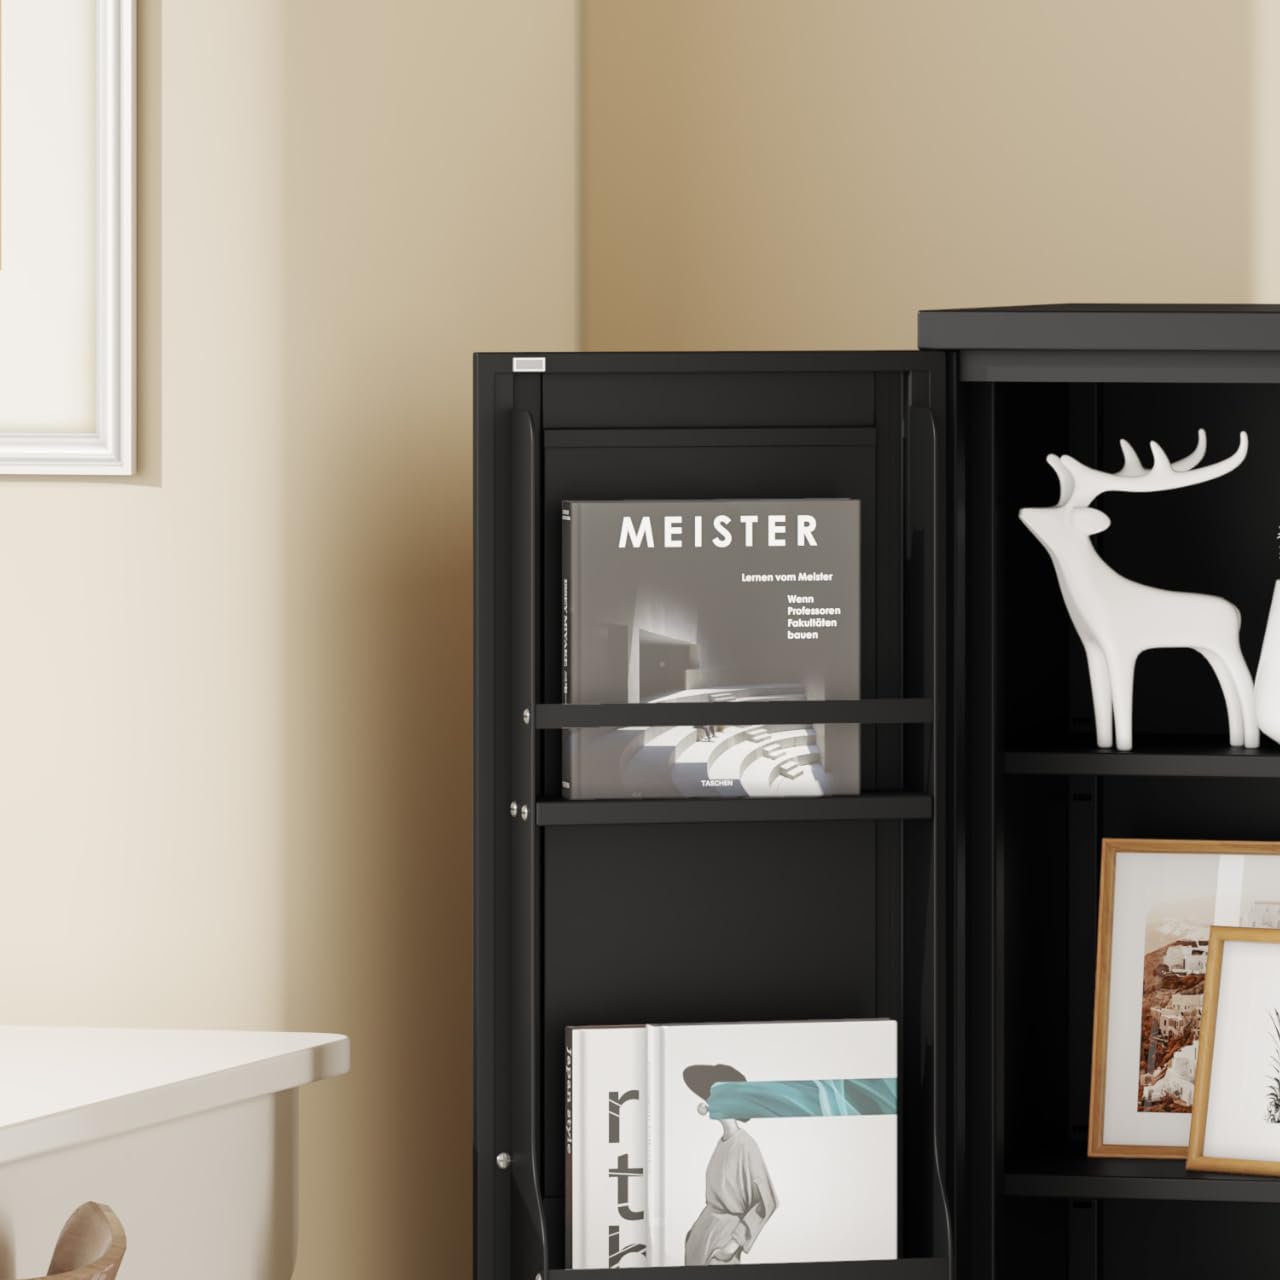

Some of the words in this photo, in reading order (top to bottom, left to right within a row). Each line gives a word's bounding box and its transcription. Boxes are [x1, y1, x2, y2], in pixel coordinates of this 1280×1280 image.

[618, 514, 818, 548] MEISTER
[741, 572, 774, 582] Lernen
[775, 574, 797, 582] vom
[798, 571, 834, 582] Meister
[787, 594, 814, 604] Wenn
[787, 605, 841, 616] Professoren
[787, 617, 838, 628] Fakultäten
[787, 630, 819, 640] bauen
[700, 779, 733, 787] TASCHEN
